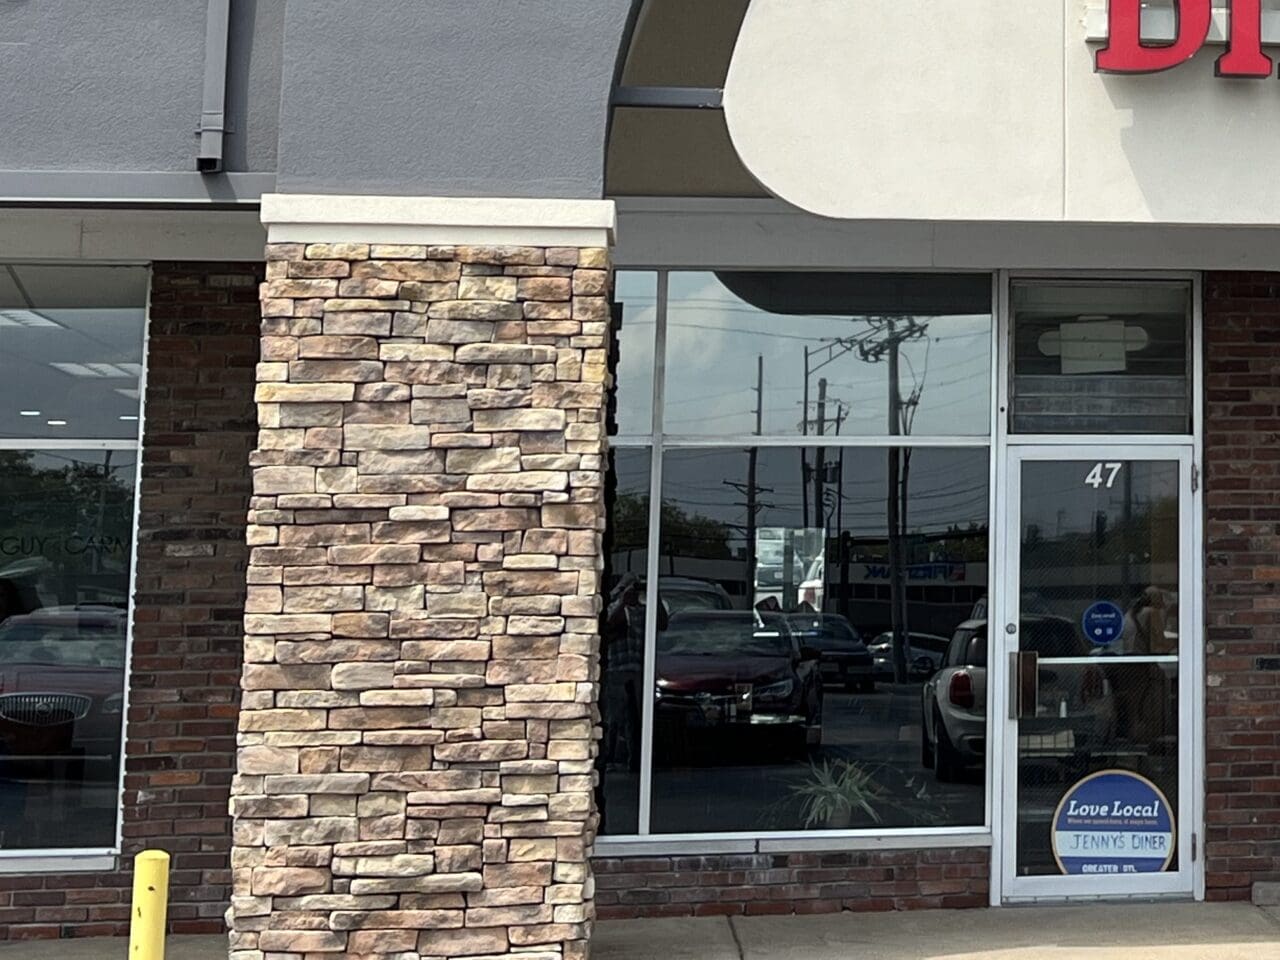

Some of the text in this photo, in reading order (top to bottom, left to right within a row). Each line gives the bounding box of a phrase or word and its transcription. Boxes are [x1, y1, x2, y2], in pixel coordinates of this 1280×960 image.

[1085, 462, 1122, 489] 47
[1067, 800, 1160, 817] Love Local
[1070, 831, 1167, 850] JENNY'S DINER
